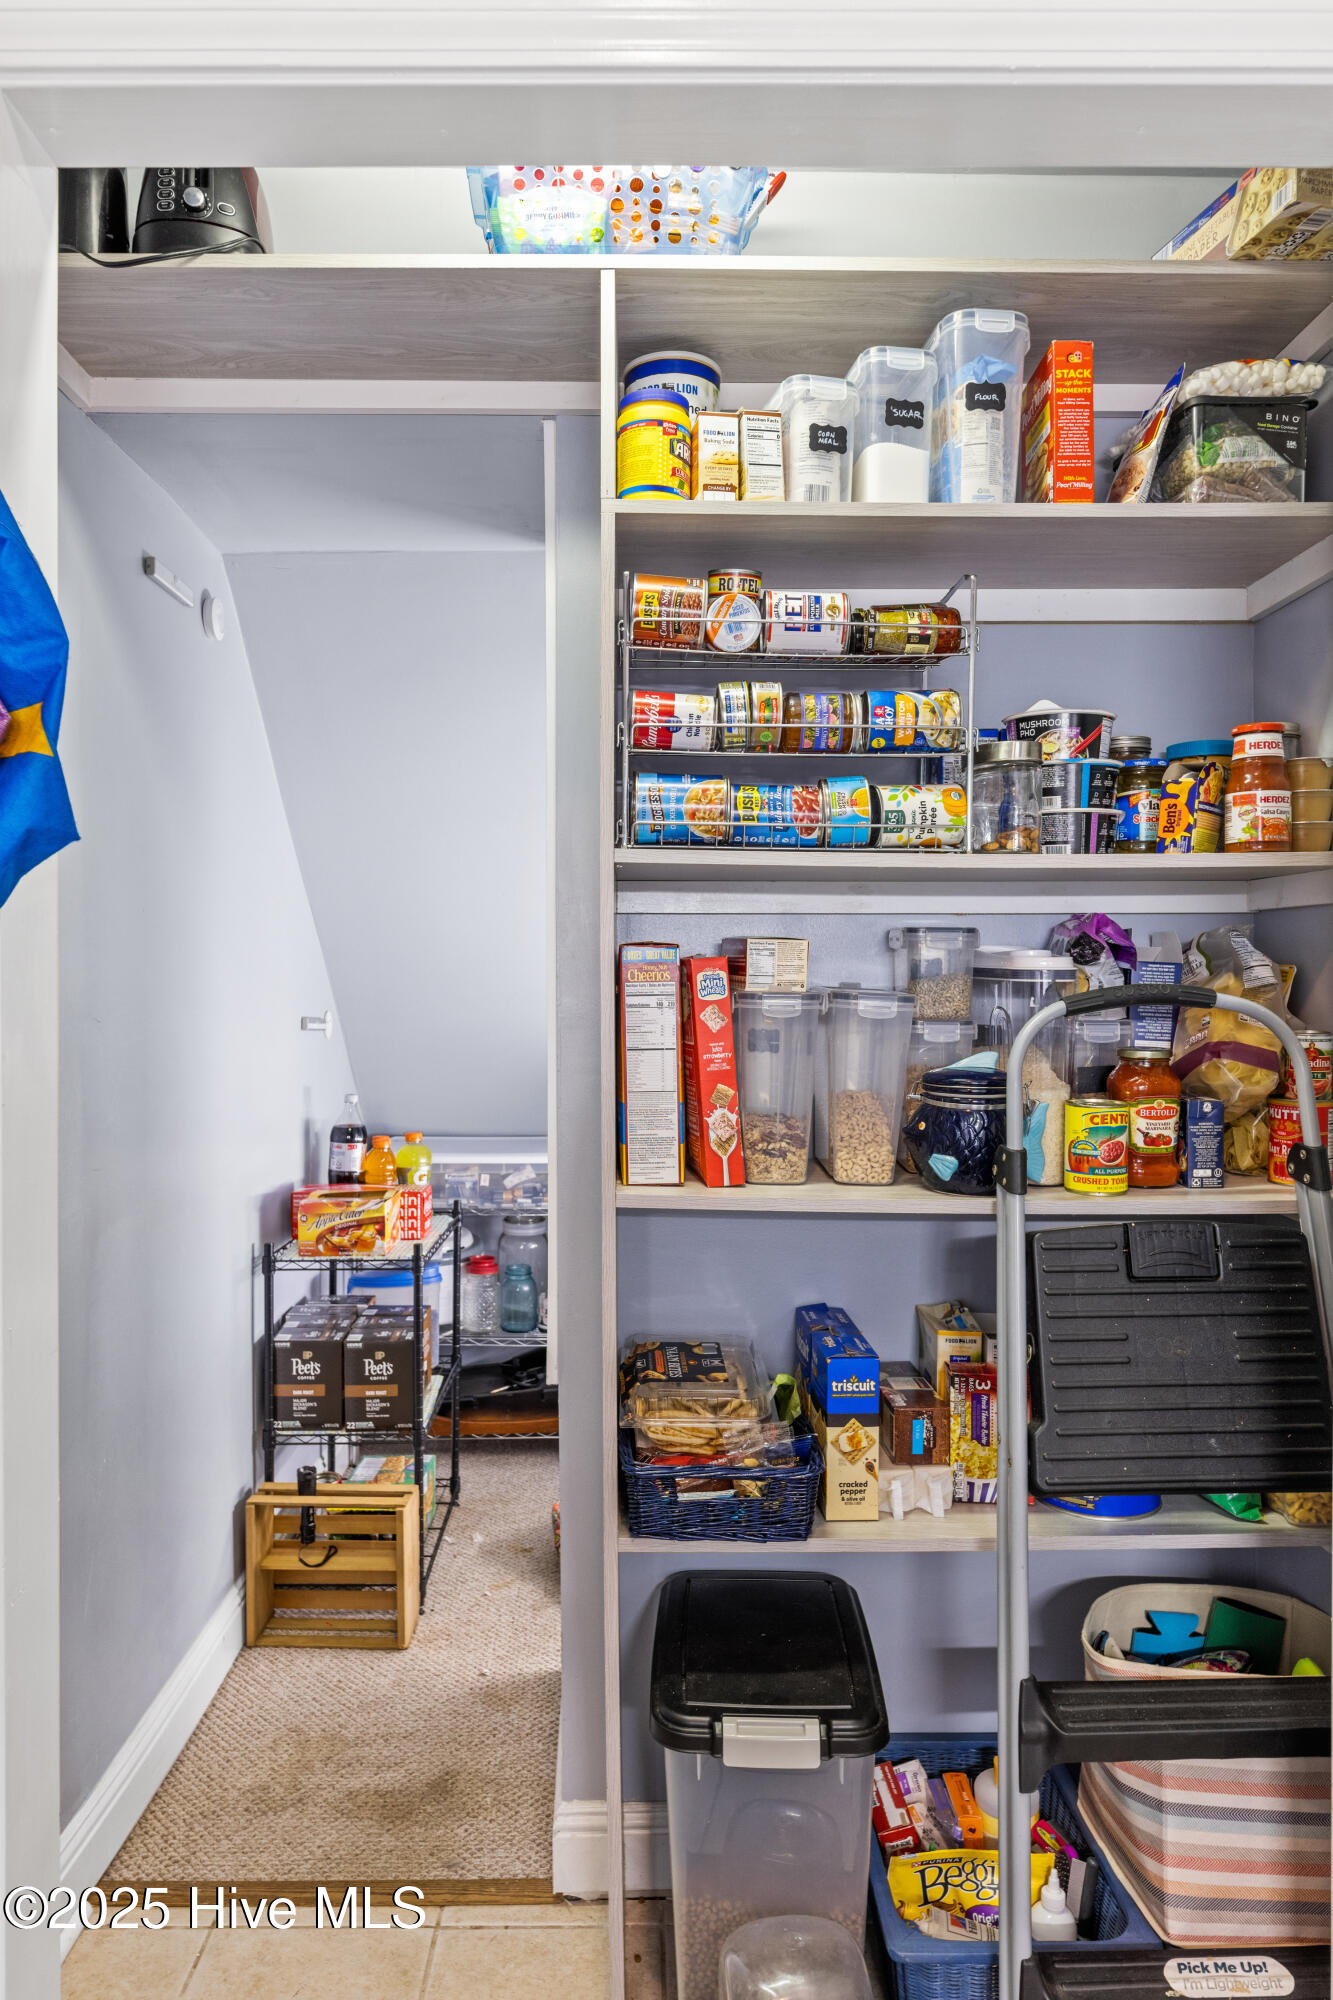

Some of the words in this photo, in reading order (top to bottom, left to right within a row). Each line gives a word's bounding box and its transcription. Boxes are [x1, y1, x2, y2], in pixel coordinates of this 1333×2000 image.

[1056, 370, 1091, 378] STACK
[677, 384, 698, 395] LION
[975, 394, 999, 402] FLOUR
[892, 408, 923, 420] SUGAR
[1266, 413, 1299, 422] BINO
[818, 438, 838, 446] MEAL
[675, 442, 690, 461] AR
[643, 594, 655, 625] BUSH'S
[686, 713, 694, 737] Chiken
[1020, 729, 1035, 738] PHO
[1249, 741, 1283, 750] HERDE
[742, 787, 755, 822] BUSH'S
[1141, 800, 1160, 810] vla
[1260, 796, 1290, 804] HERDEZ
[650, 786, 663, 830] POGRESSO
[888, 813, 898, 831] 365
[1162, 804, 1177, 833] Ben's
[628, 969, 671, 981] Cheerios
[700, 978, 723, 989] Mini
[699, 985, 725, 997] Wheats
[703, 1052, 732, 1060] strawberry
[1270, 1108, 1300, 1120] MUTT
[1073, 1176, 1109, 1185] CRUSHED
[1112, 1176, 1128, 1185] TOM
[307, 1215, 336, 1232] Apple
[335, 1221, 357, 1230] ORIGINAL
[291, 1358, 321, 1376] Peet's
[363, 1359, 393, 1376] Peet's
[832, 1380, 876, 1392] triscuit
[975, 1379, 991, 1390] 3
[981, 1410, 989, 1428] Theater
[981, 1429, 989, 1445] Butter
[914, 1857, 999, 1908] Beggi
[973, 1912, 999, 1927] Origin
[1177, 1962, 1211, 1974] Pick
[1213, 1962, 1237, 1973] Me
[1240, 1961, 1268, 1975] Up!
[1183, 1979, 1203, 1990] I'm
